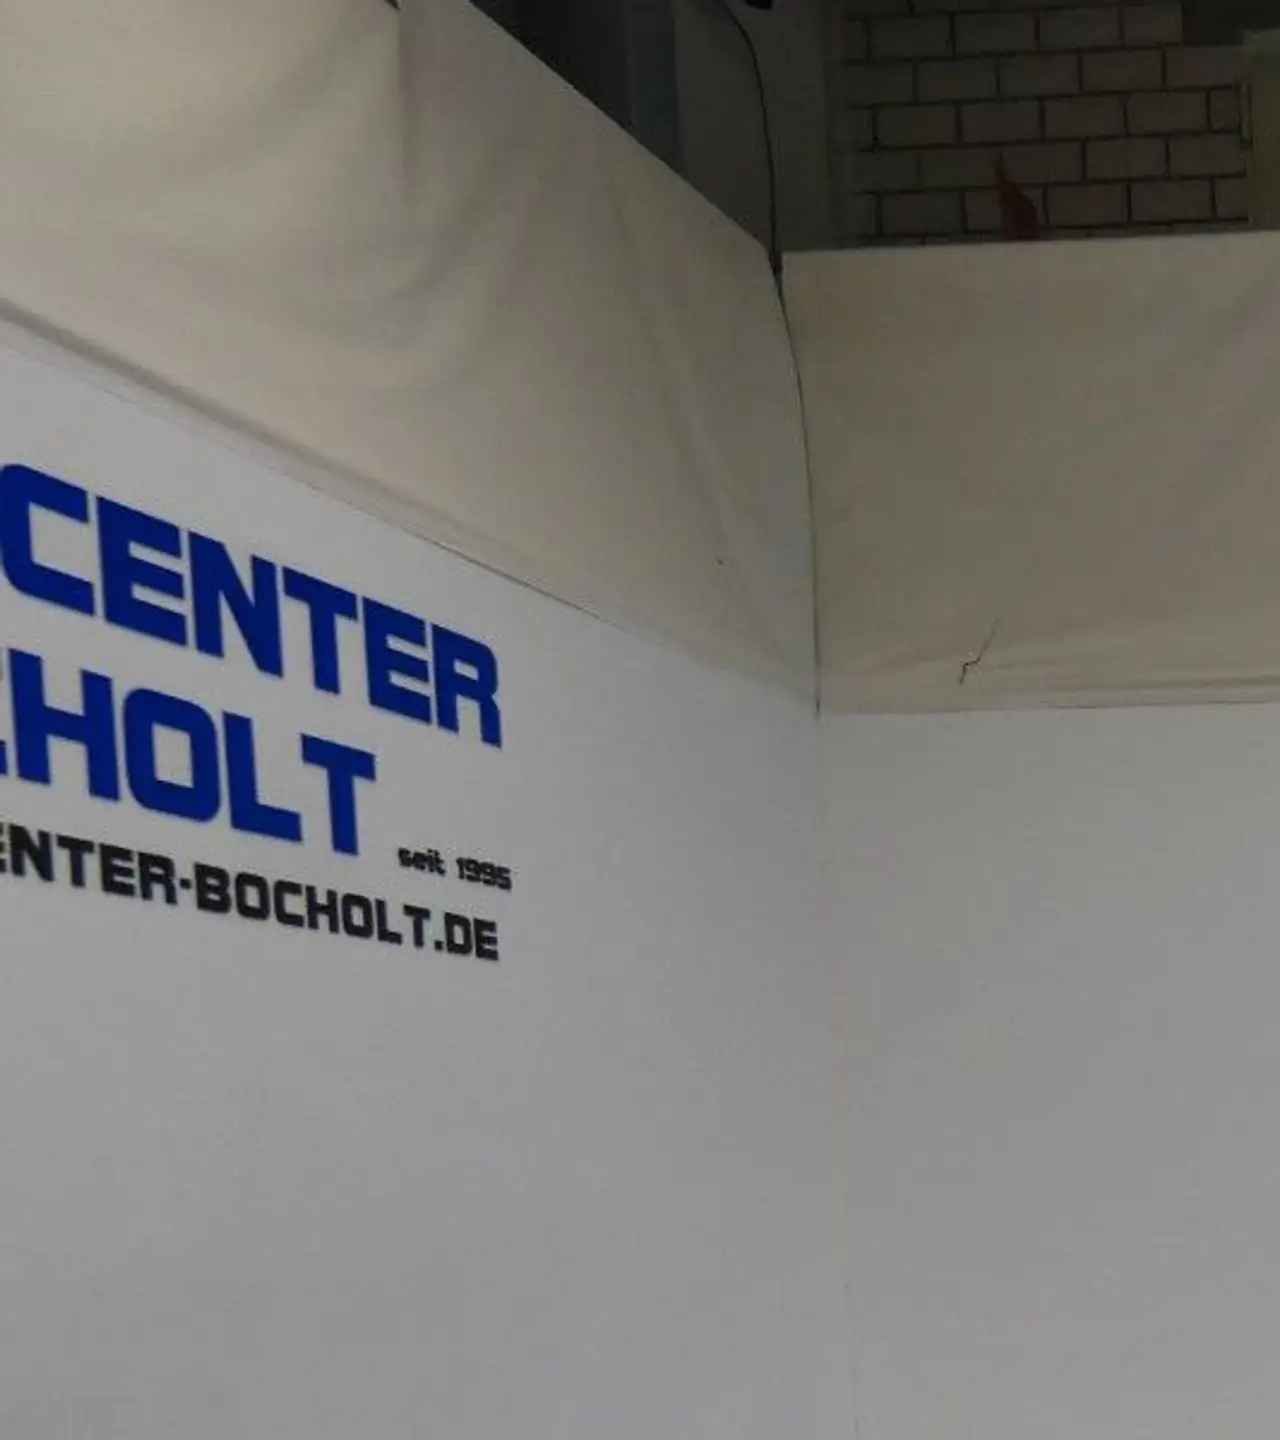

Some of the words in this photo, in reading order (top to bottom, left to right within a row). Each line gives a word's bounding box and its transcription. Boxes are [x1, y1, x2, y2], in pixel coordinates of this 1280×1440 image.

[0, 463, 502, 748] CENTER
[0, 648, 377, 857] HOLT
[0, 820, 500, 963] NTER-BOCHOLT.DE
[397, 846, 447, 877] seit
[455, 856, 513, 891] 1995
